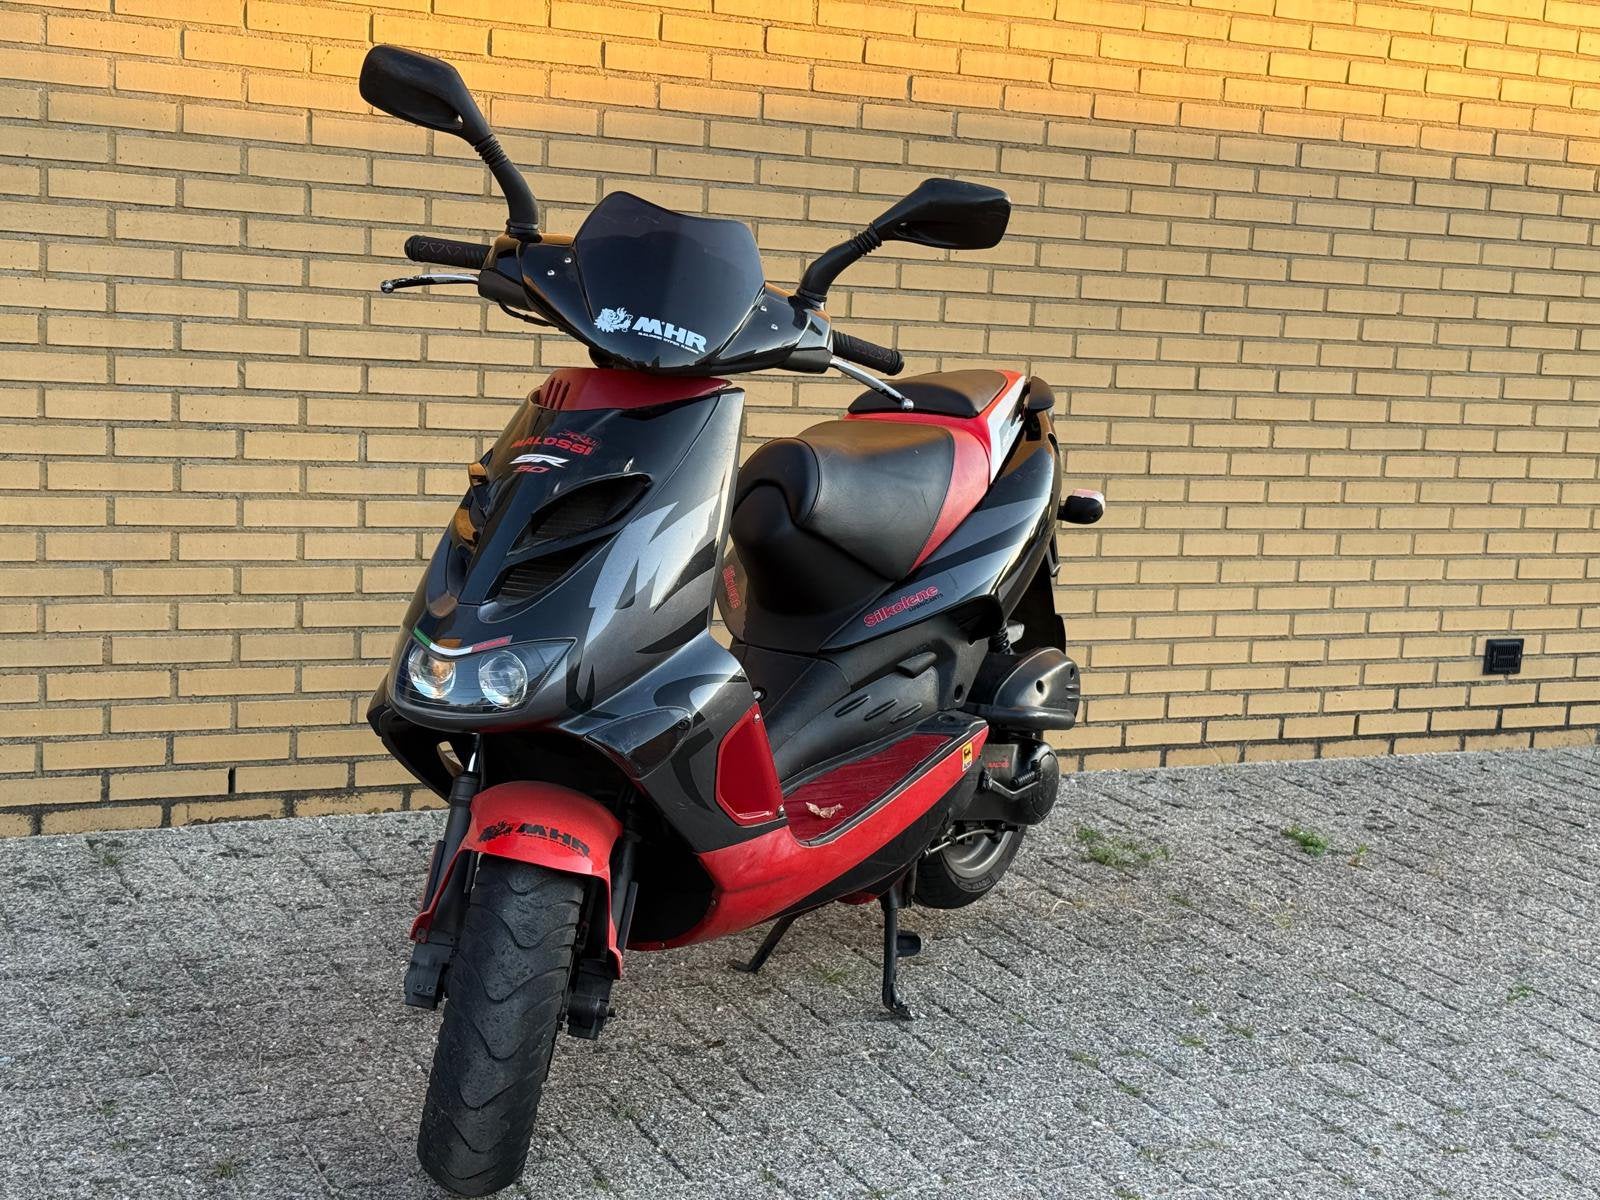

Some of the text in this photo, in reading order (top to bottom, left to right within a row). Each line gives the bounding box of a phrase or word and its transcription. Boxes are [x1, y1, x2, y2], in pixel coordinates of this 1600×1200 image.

[513, 465, 550, 474] 50
[864, 587, 938, 628] Silkolene
[516, 823, 590, 858] MHR
